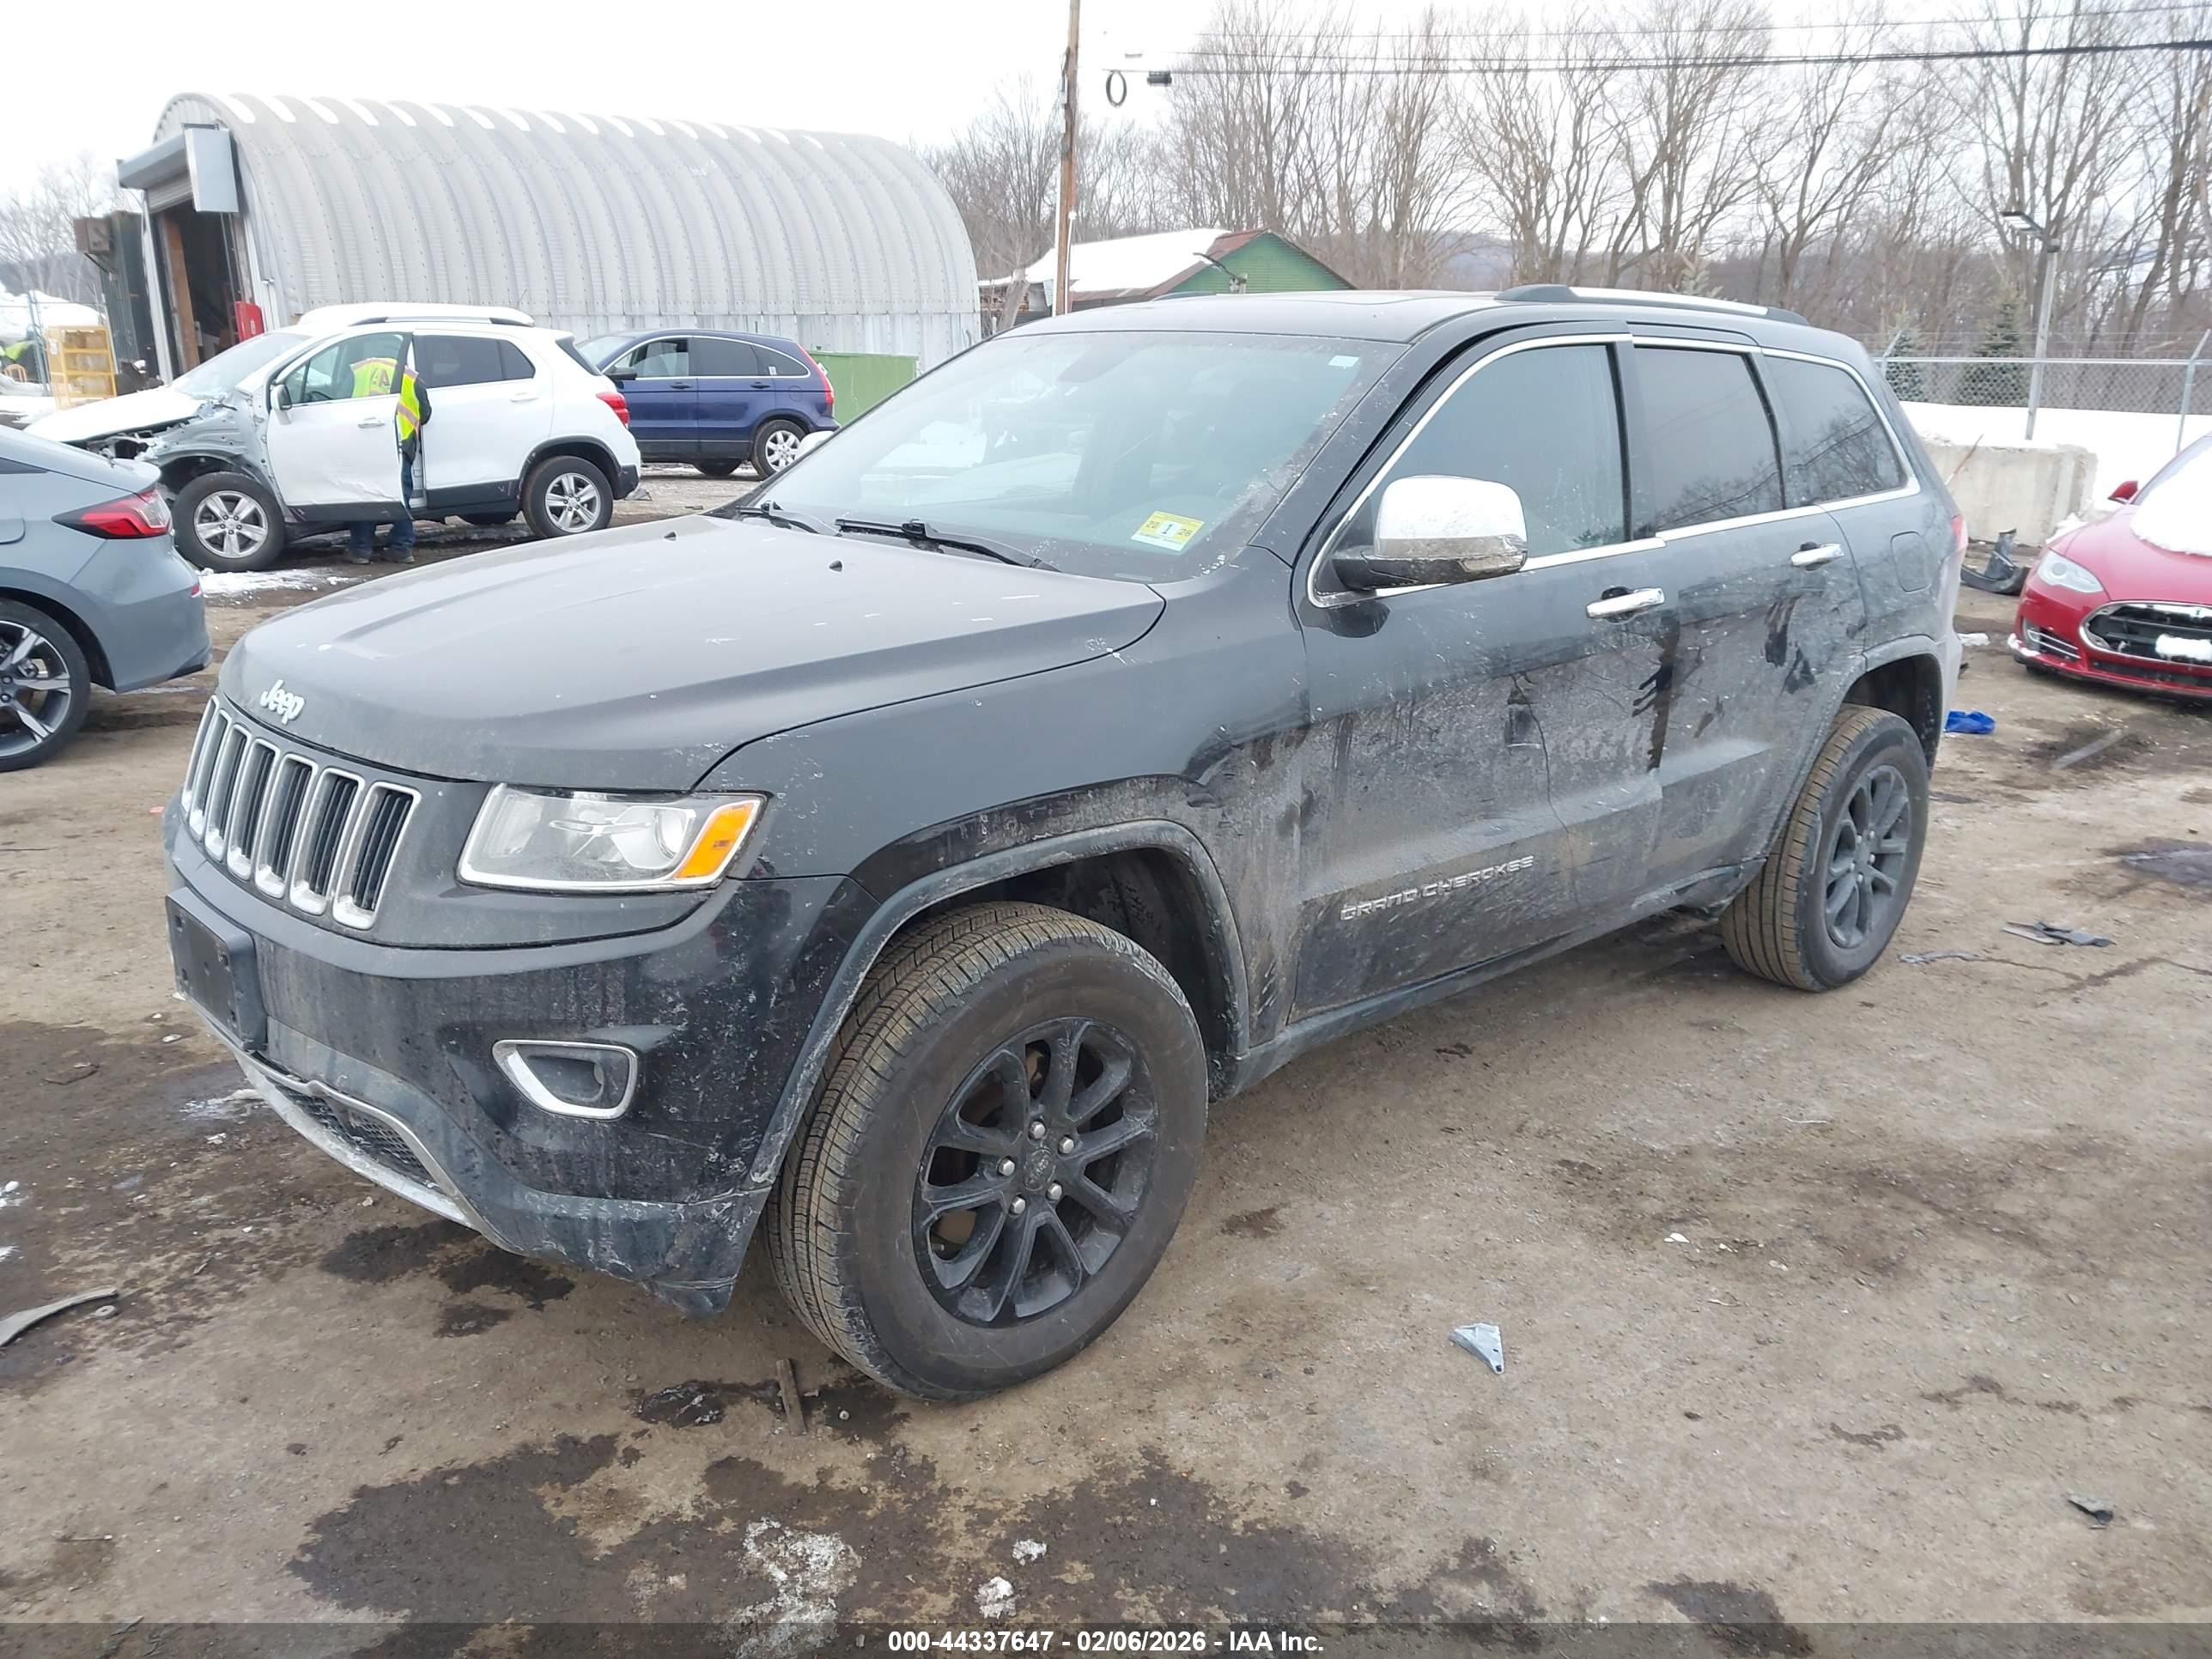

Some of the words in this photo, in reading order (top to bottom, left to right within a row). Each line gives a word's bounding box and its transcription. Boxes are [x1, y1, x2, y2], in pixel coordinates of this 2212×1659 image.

[259, 678, 306, 726] Jeep
[1340, 888, 1419, 921] GRAND
[1421, 855, 1534, 897] CHEROKEE
